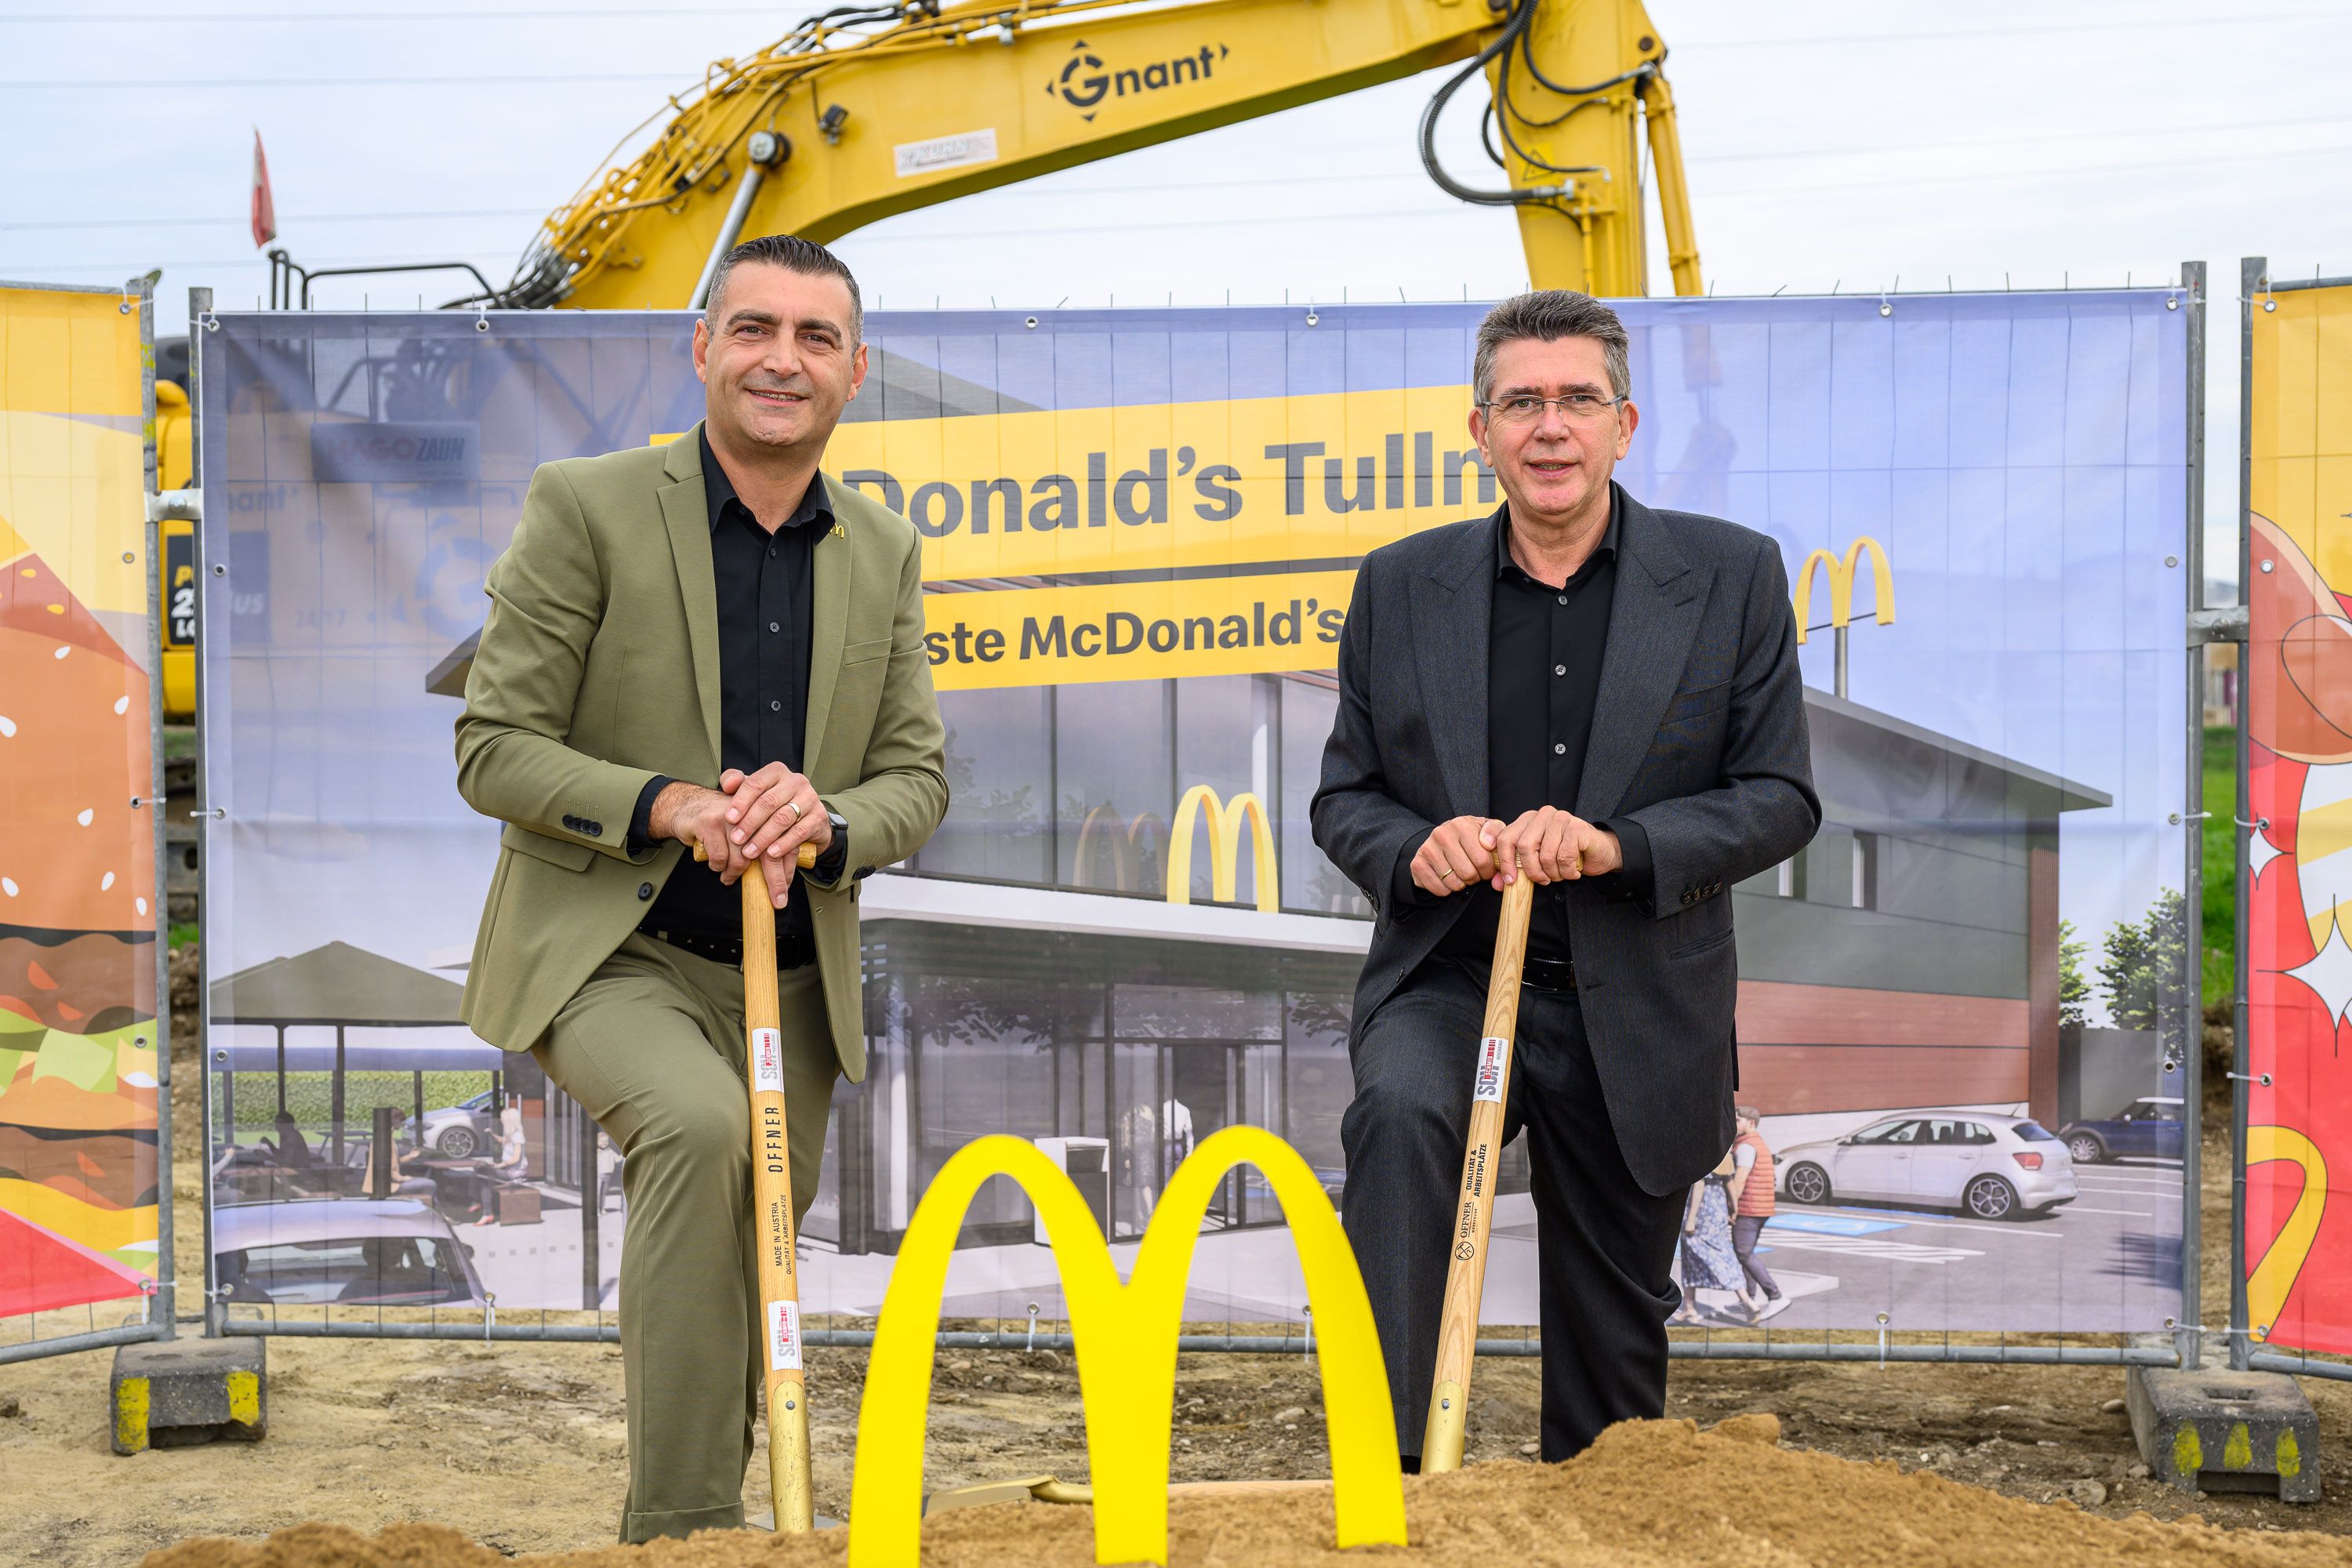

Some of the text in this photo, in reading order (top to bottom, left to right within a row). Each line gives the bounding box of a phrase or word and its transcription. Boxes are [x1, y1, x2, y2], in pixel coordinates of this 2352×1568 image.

[1061, 46, 1214, 107] Gnant
[842, 431, 1497, 538] Donald's Tulln
[924, 598, 1345, 666] ste McDonald's
[1485, 1055, 1494, 1076] SCHMID
[764, 1107, 783, 1173] OFFNER
[1466, 1157, 1476, 1190] QUALITÄT
[1474, 1144, 1487, 1197] ARBEITSPLÄTZE
[771, 1202, 781, 1233] AUSTRIA
[1460, 1201, 1472, 1238] OFFNER
